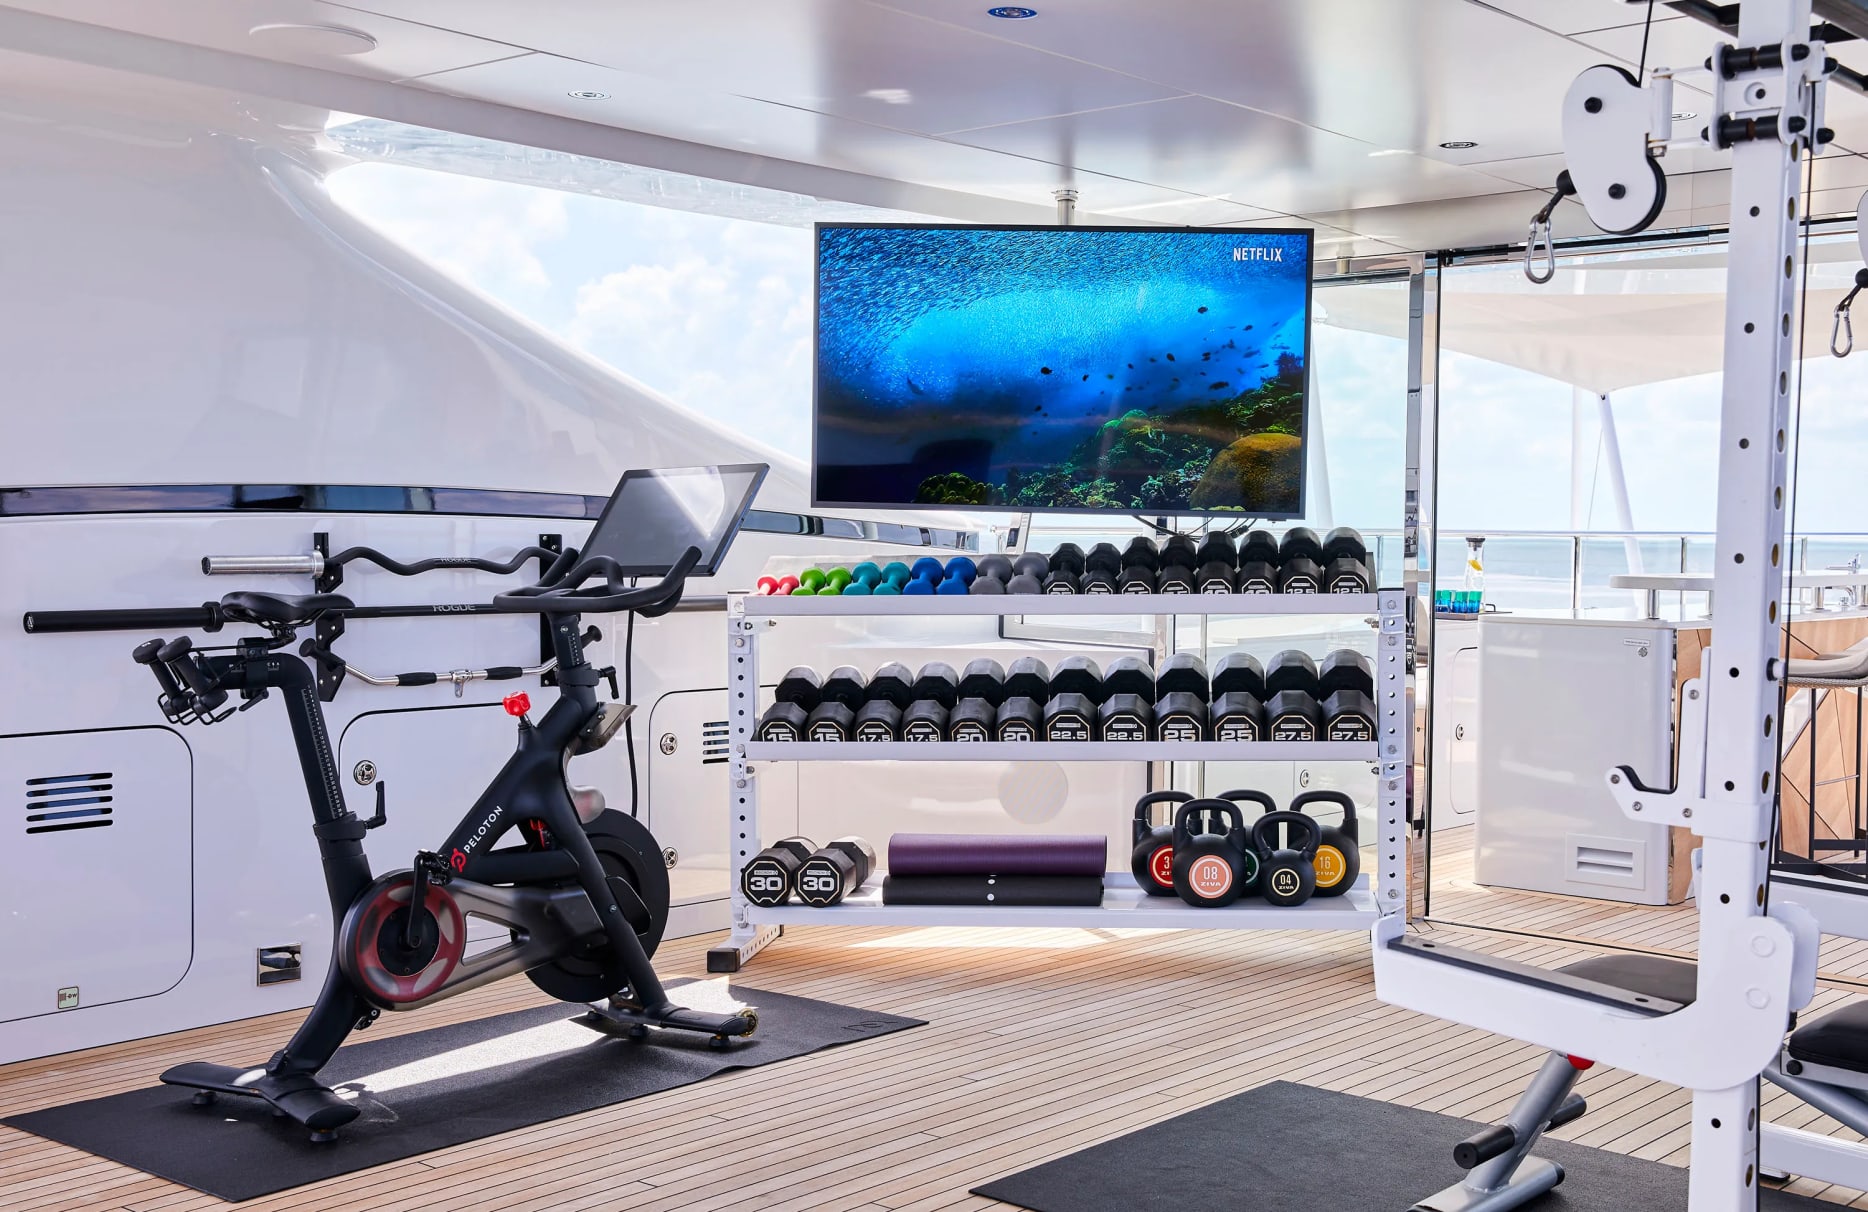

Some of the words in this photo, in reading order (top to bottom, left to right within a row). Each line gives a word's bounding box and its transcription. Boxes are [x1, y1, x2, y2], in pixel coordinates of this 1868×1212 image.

[1233, 248, 1282, 262] NETFLIX
[767, 734, 793, 742] 15
[814, 734, 840, 742] 15
[956, 734, 983, 742] 20
[1003, 733, 1030, 742] 20
[1051, 731, 1087, 740] 22.5
[1107, 732, 1143, 740] 22.5
[1164, 730, 1196, 742] 25
[1220, 730, 1253, 742] 25
[1275, 732, 1312, 741] 27.5
[1331, 732, 1369, 741] 27.5
[464, 805, 503, 853] PELOTON
[1320, 856, 1331, 870] 16
[1203, 866, 1218, 880] 08
[750, 877, 782, 891] 30
[803, 877, 834, 891] 30
[1280, 874, 1291, 885] 04
